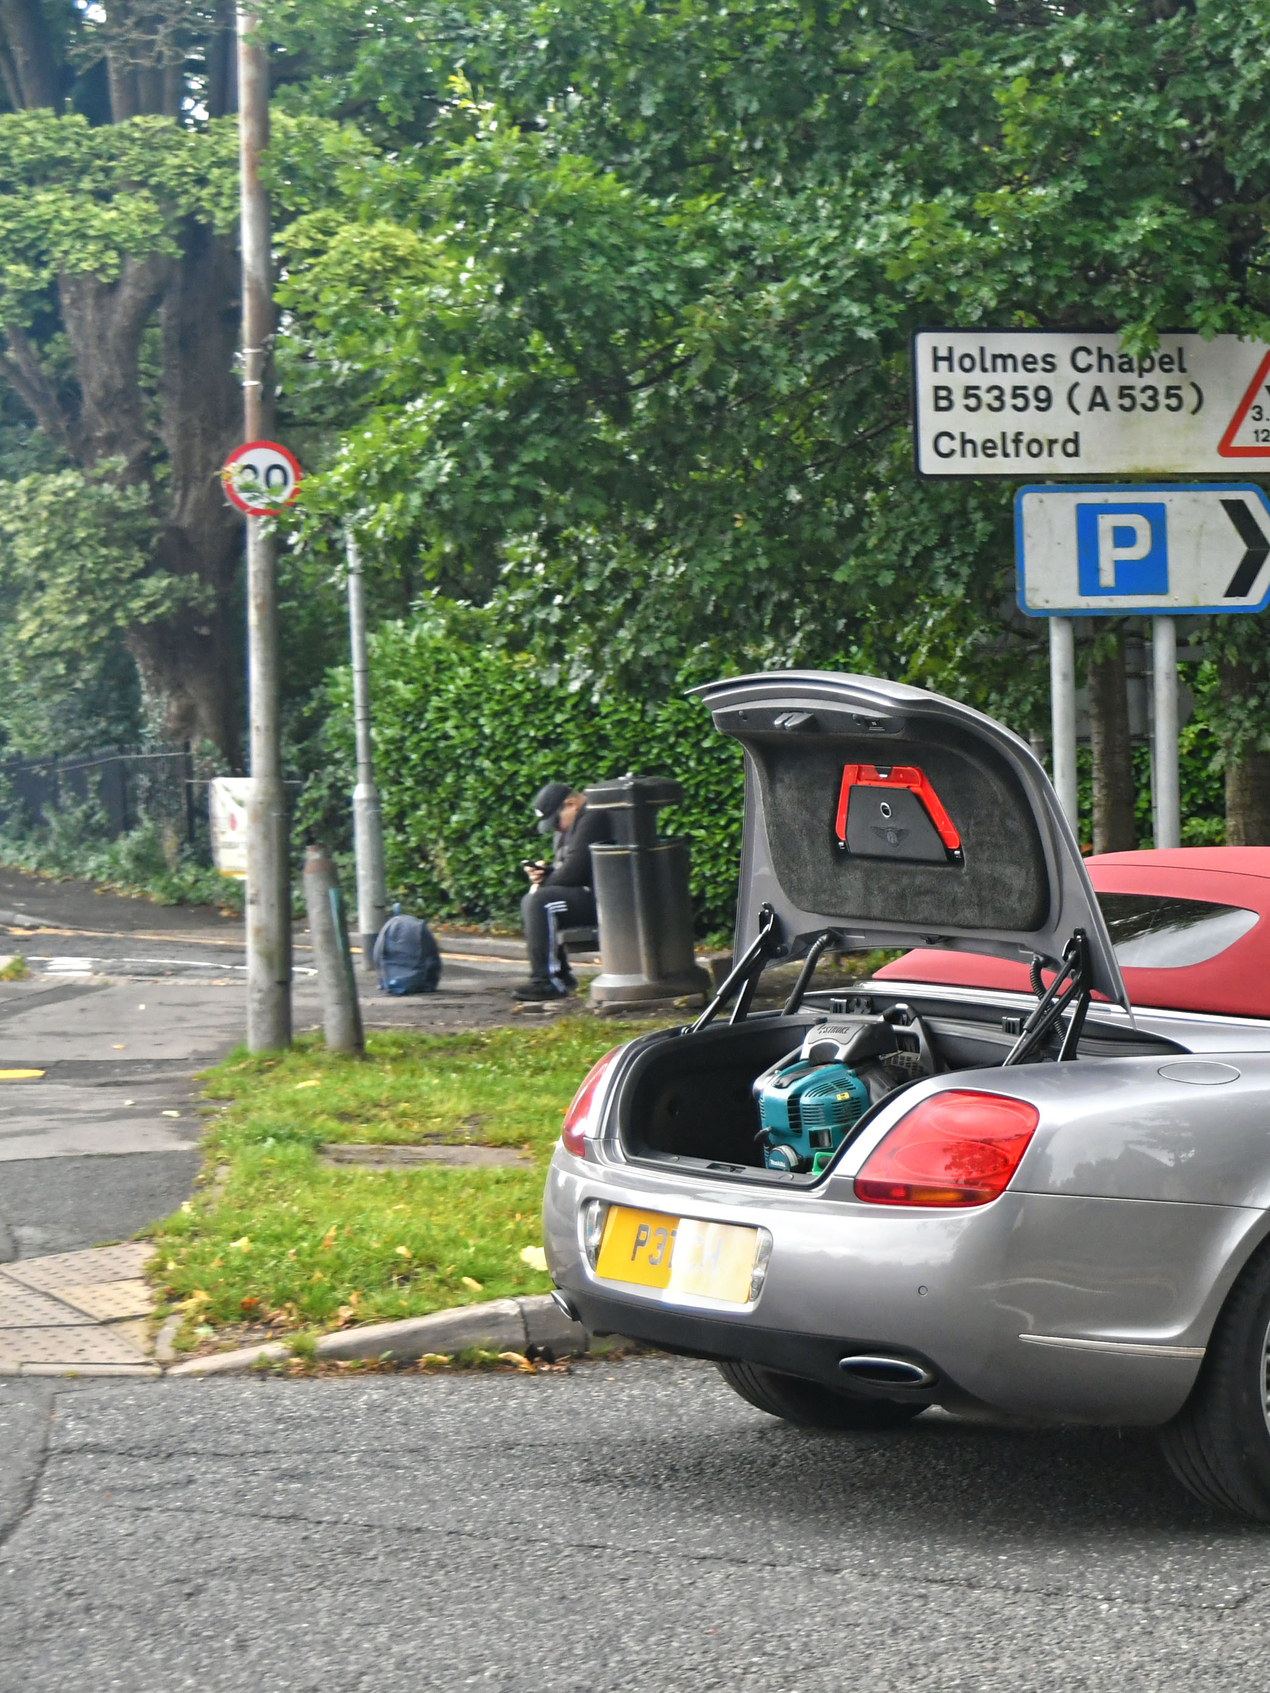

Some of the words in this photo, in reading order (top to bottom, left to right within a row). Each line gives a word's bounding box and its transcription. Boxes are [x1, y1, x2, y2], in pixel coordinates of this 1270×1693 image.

[931, 346, 1057, 374] Holmes
[1070, 345, 1188, 378] Chapel
[932, 430, 1080, 458] Chelford
[1097, 513, 1153, 588] P
